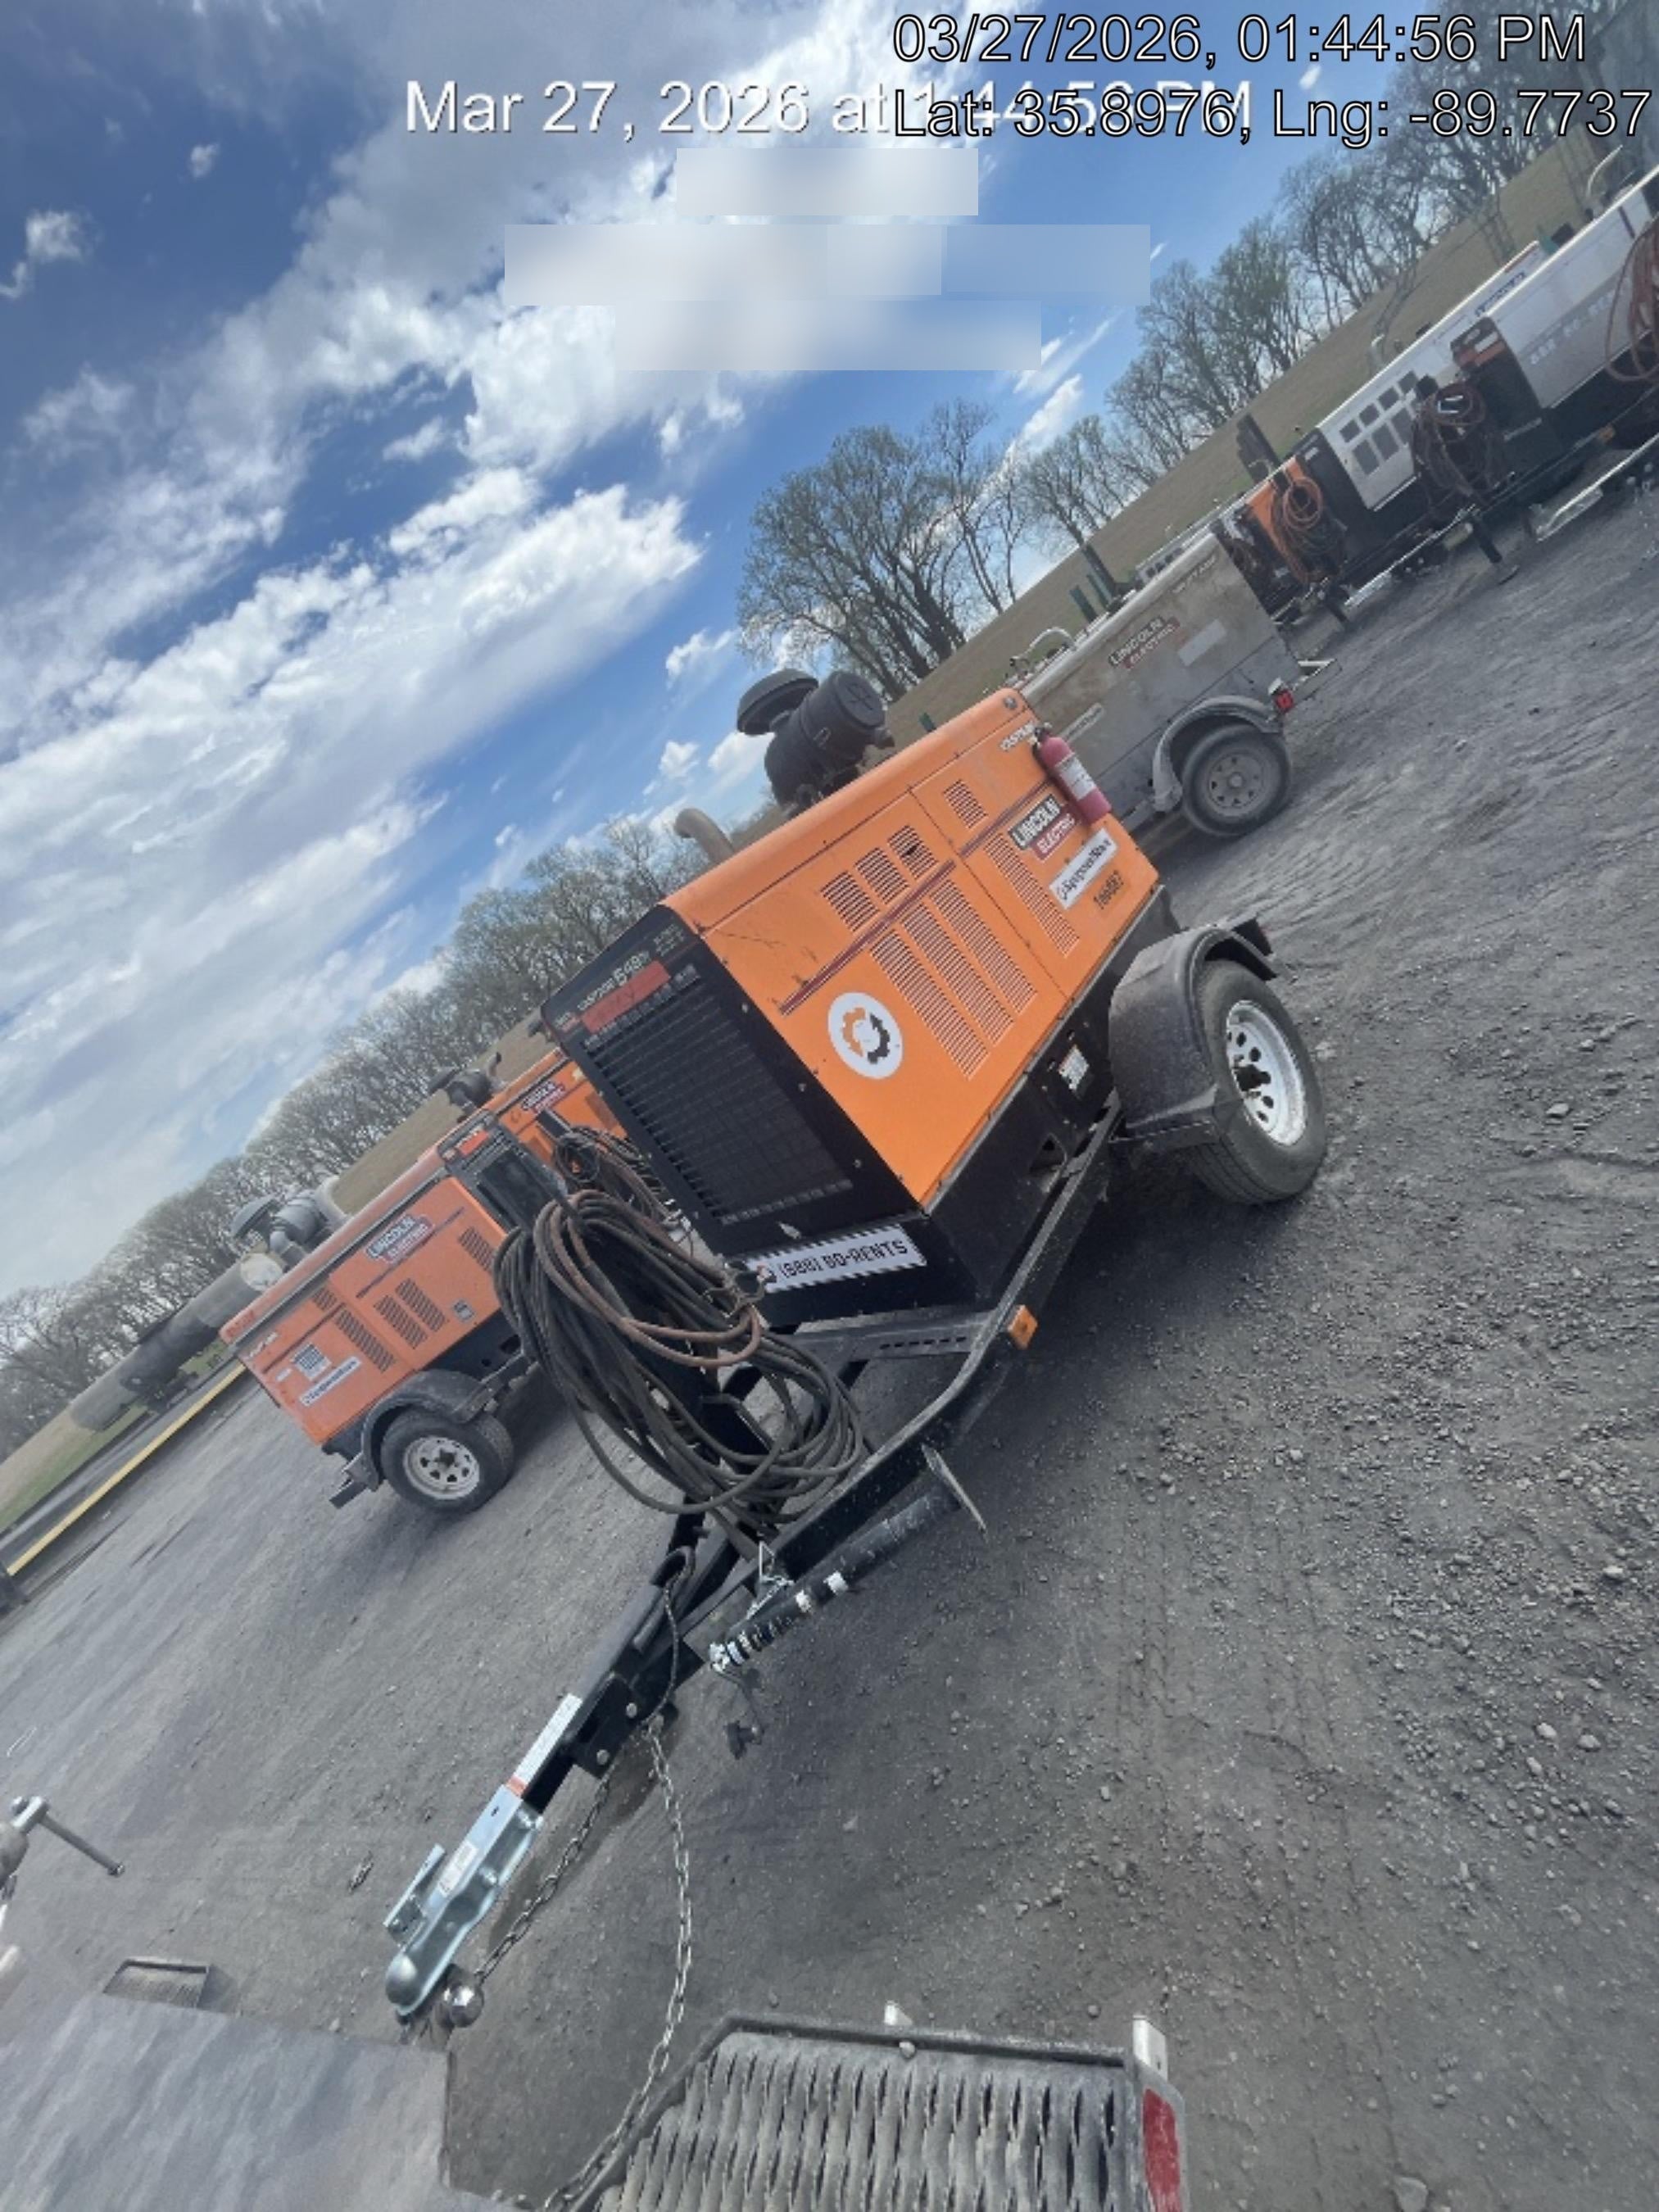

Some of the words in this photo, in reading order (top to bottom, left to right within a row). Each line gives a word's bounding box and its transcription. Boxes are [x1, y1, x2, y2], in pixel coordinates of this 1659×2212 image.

[1109, 618, 1164, 665] LINCOLN
[1012, 797, 1061, 847] LINCOLN
[1036, 812, 1077, 854] ELECTRIC
